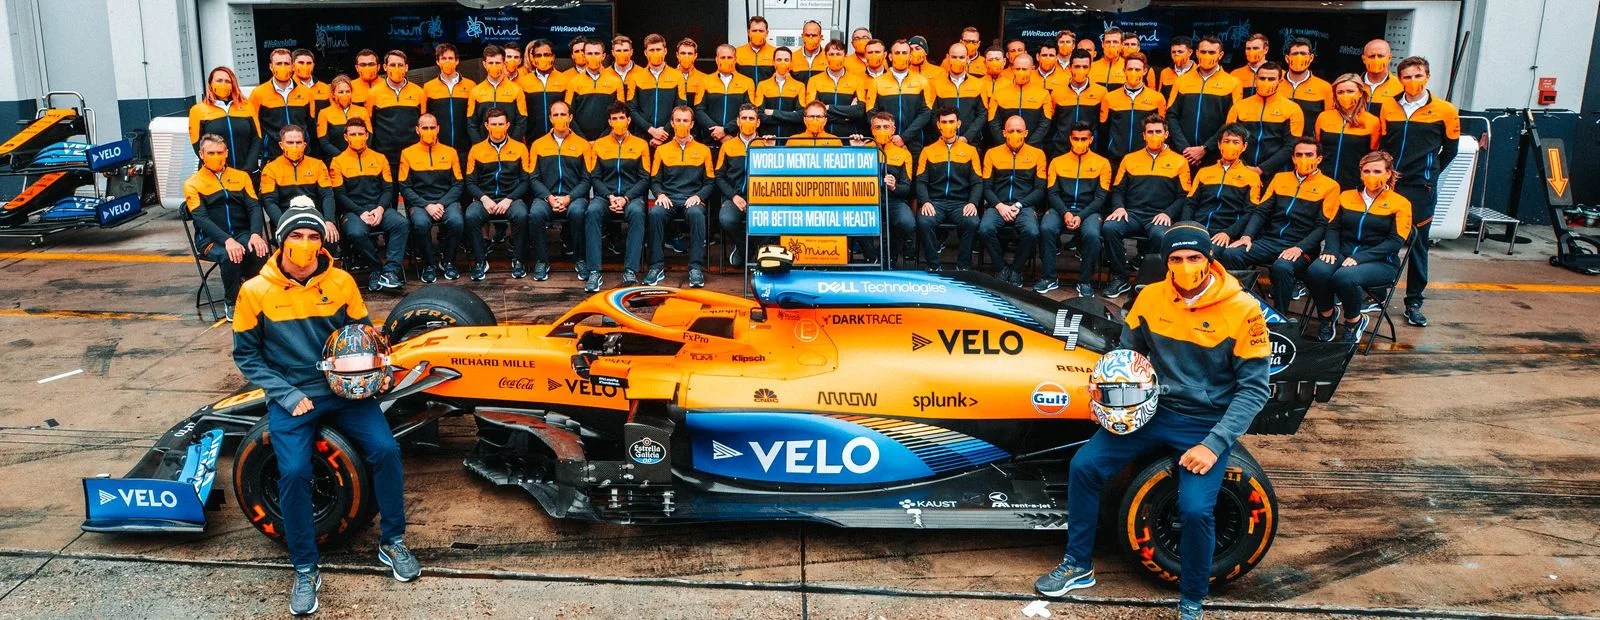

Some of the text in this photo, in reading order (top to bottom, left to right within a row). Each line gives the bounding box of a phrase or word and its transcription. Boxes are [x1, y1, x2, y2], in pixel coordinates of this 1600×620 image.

[482, 23, 522, 36] mind
[550, 25, 596, 33] #WeRaceAsOne
[98, 146, 121, 160] VELO
[753, 152, 875, 169] WORLD MENTAL HEALTH DAY
[752, 181, 876, 197] McLAREN SUPPORTING MIND
[109, 201, 131, 216] VELO
[752, 210, 876, 227] FOR BETTER MENTAL HEALTH
[804, 244, 840, 256] mind
[818, 281, 946, 294] DELL Technologies
[832, 313, 903, 325] DARKTRACE
[1053, 309, 1083, 351] 4
[682, 332, 709, 344] FxPro
[938, 329, 1024, 355] VELO
[451, 357, 536, 369] RICHARD MILLE
[731, 354, 766, 363] Klipsch
[1056, 365, 1093, 373] RENA
[564, 378, 618, 398] VELO
[817, 391, 877, 407] ARROW
[1033, 392, 1068, 405] Gulf
[634, 444, 661, 452] Estrella
[635, 451, 660, 459] Galicia
[748, 436, 880, 474] VELO
[117, 488, 178, 508] VELO
[916, 500, 958, 508] KAUST
